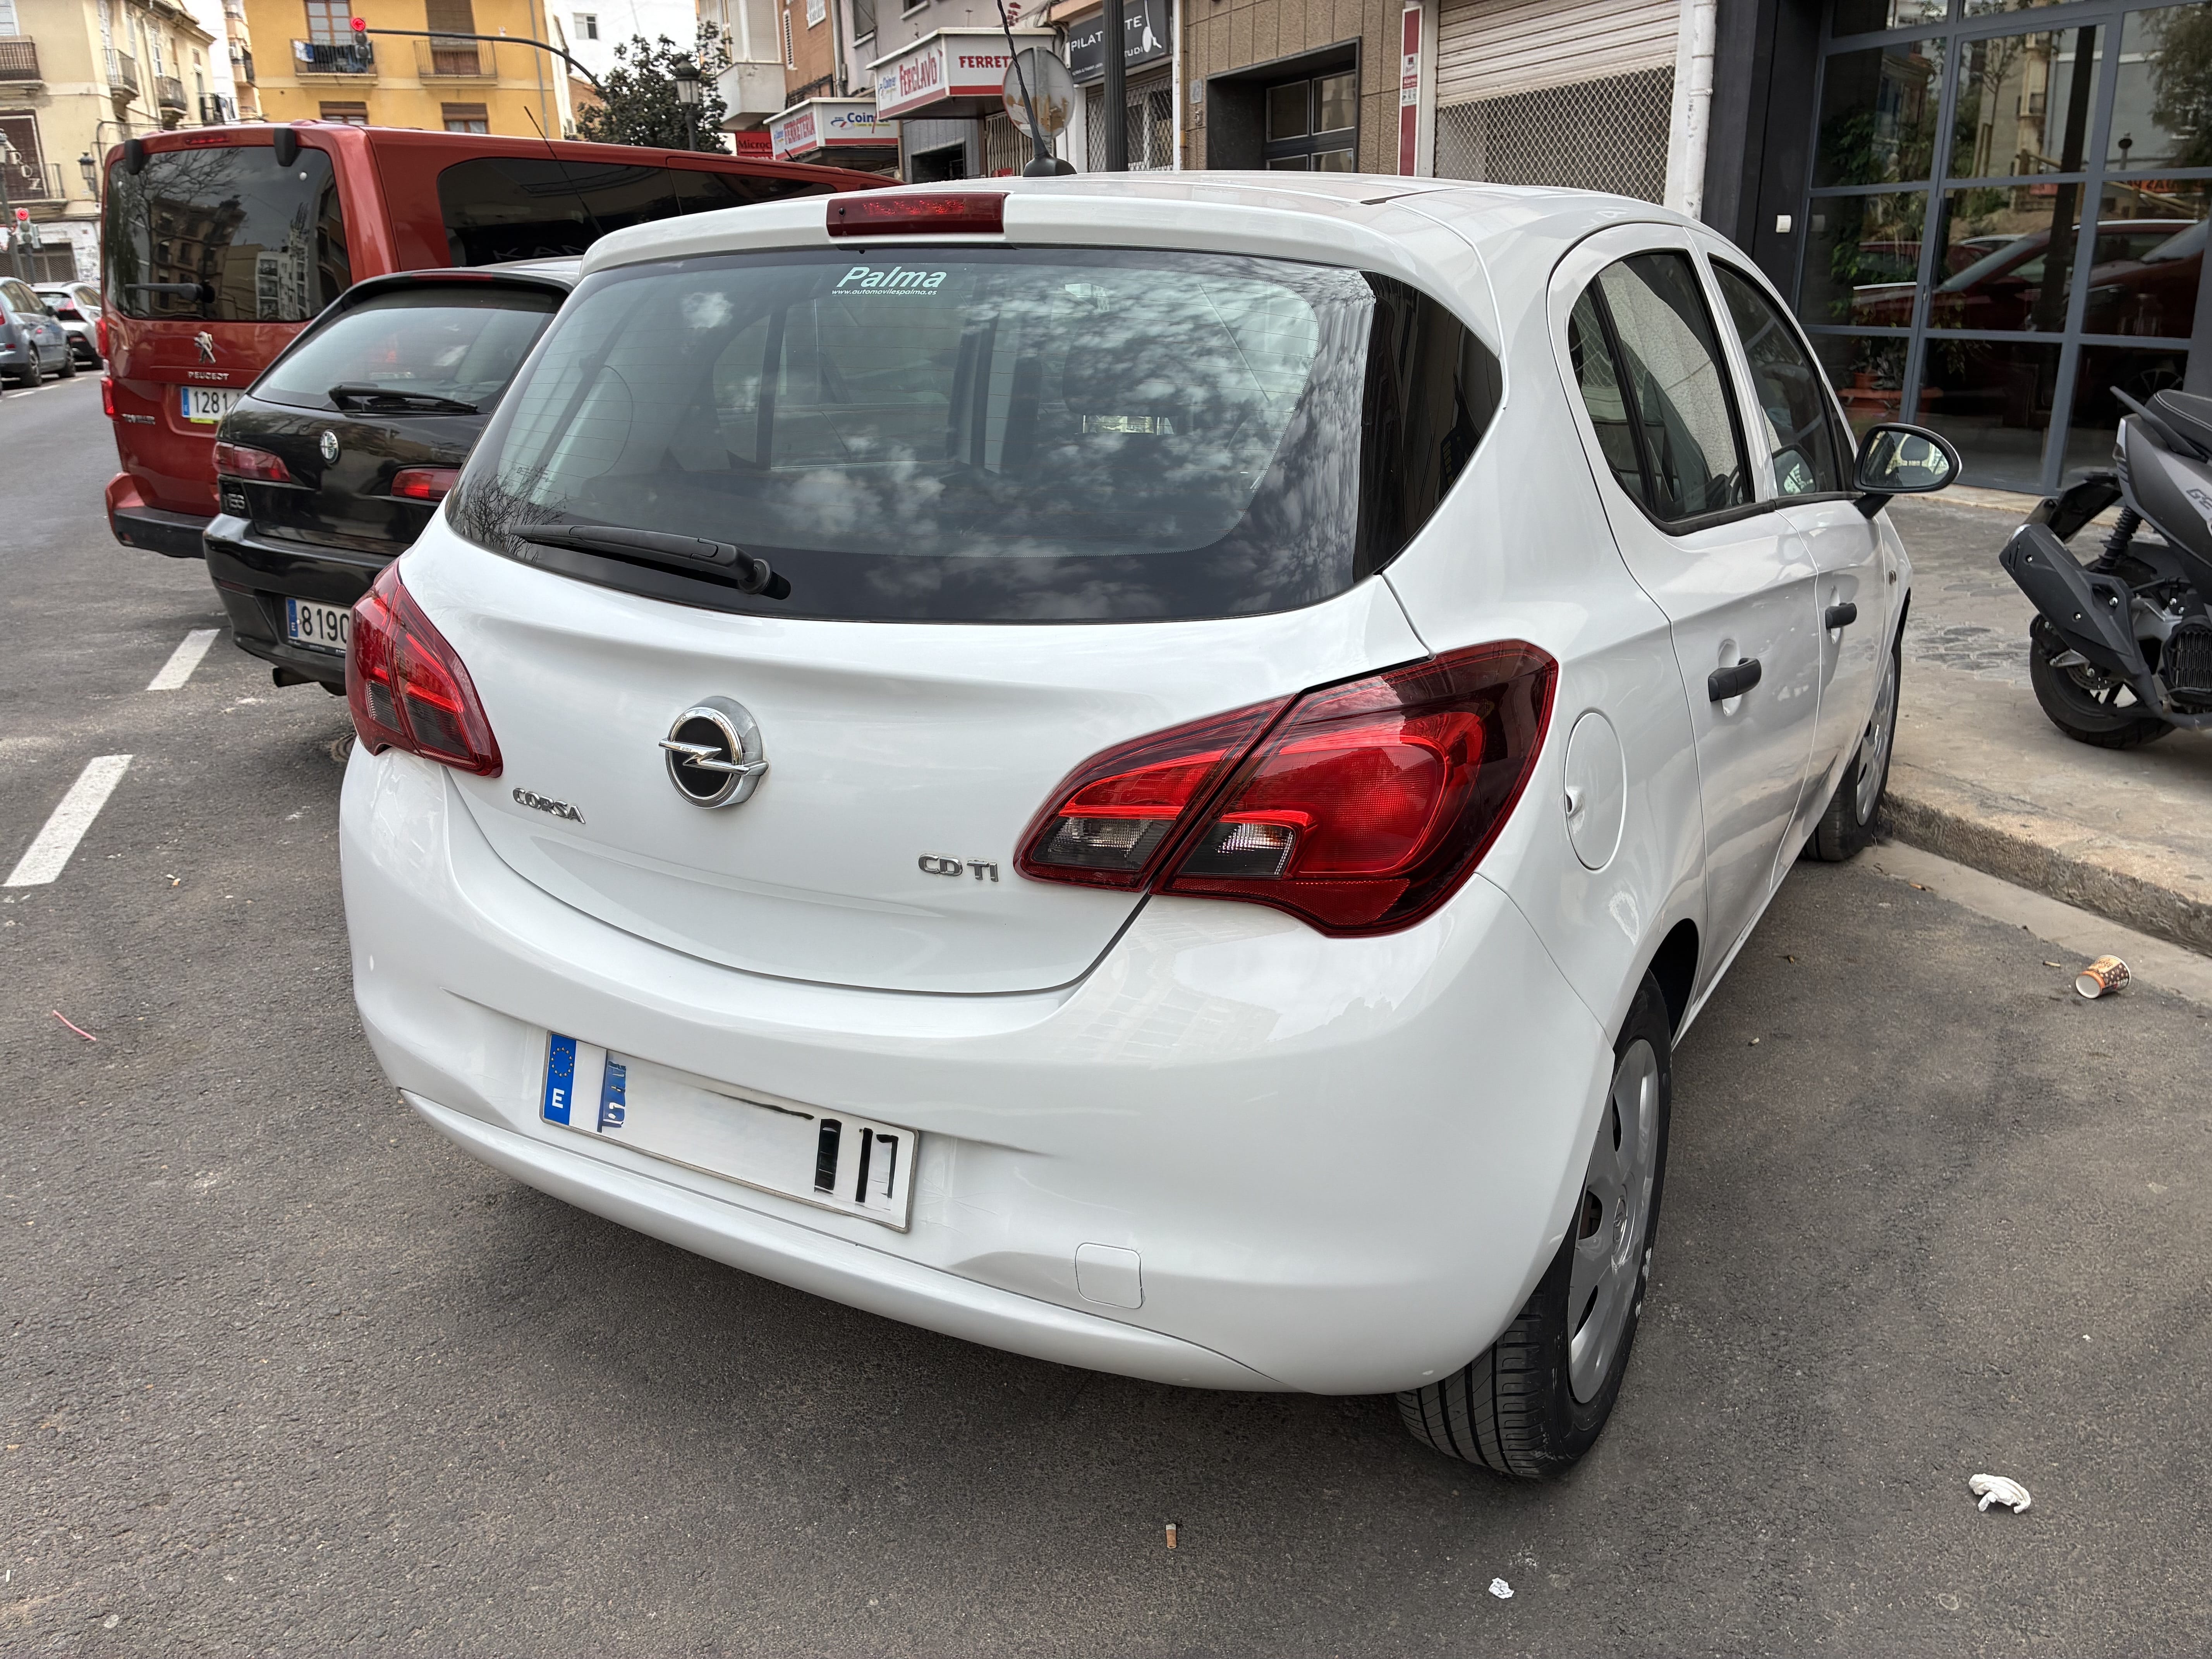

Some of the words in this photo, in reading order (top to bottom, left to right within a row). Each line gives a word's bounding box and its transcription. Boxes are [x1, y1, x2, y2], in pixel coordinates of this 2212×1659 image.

[958, 56, 1012, 68] FERRET
[836, 266, 947, 287] Palma
[187, 371, 230, 380] PEUGEOT
[194, 391, 228, 413] 1281
[512, 787, 586, 824] CORSA
[551, 1088, 565, 1109] E
